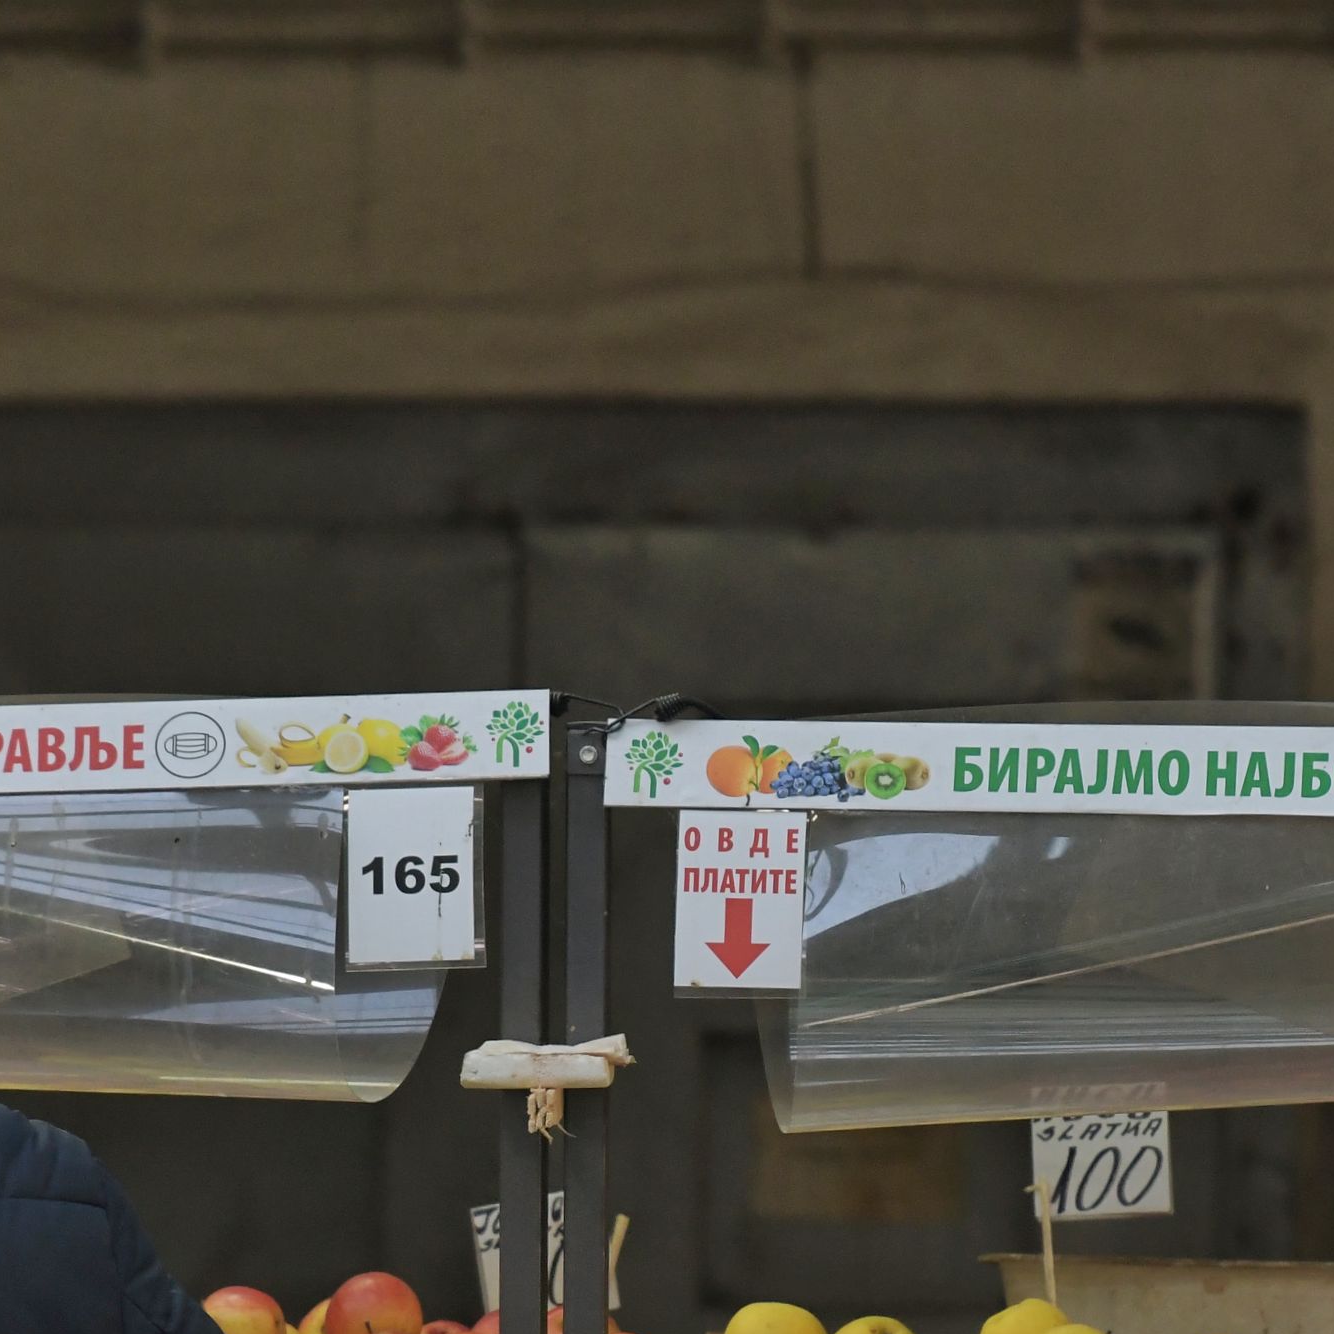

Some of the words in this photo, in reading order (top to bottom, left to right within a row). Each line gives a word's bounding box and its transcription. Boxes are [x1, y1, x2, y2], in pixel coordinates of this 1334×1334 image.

[953, 746, 1190, 796] БИРАЈМО
[362, 855, 460, 895] 165
[683, 868, 797, 894] ПЛАТИТЕ
[1037, 1118, 1163, 1142] SLATKA
[1051, 1146, 1163, 1214] 100
